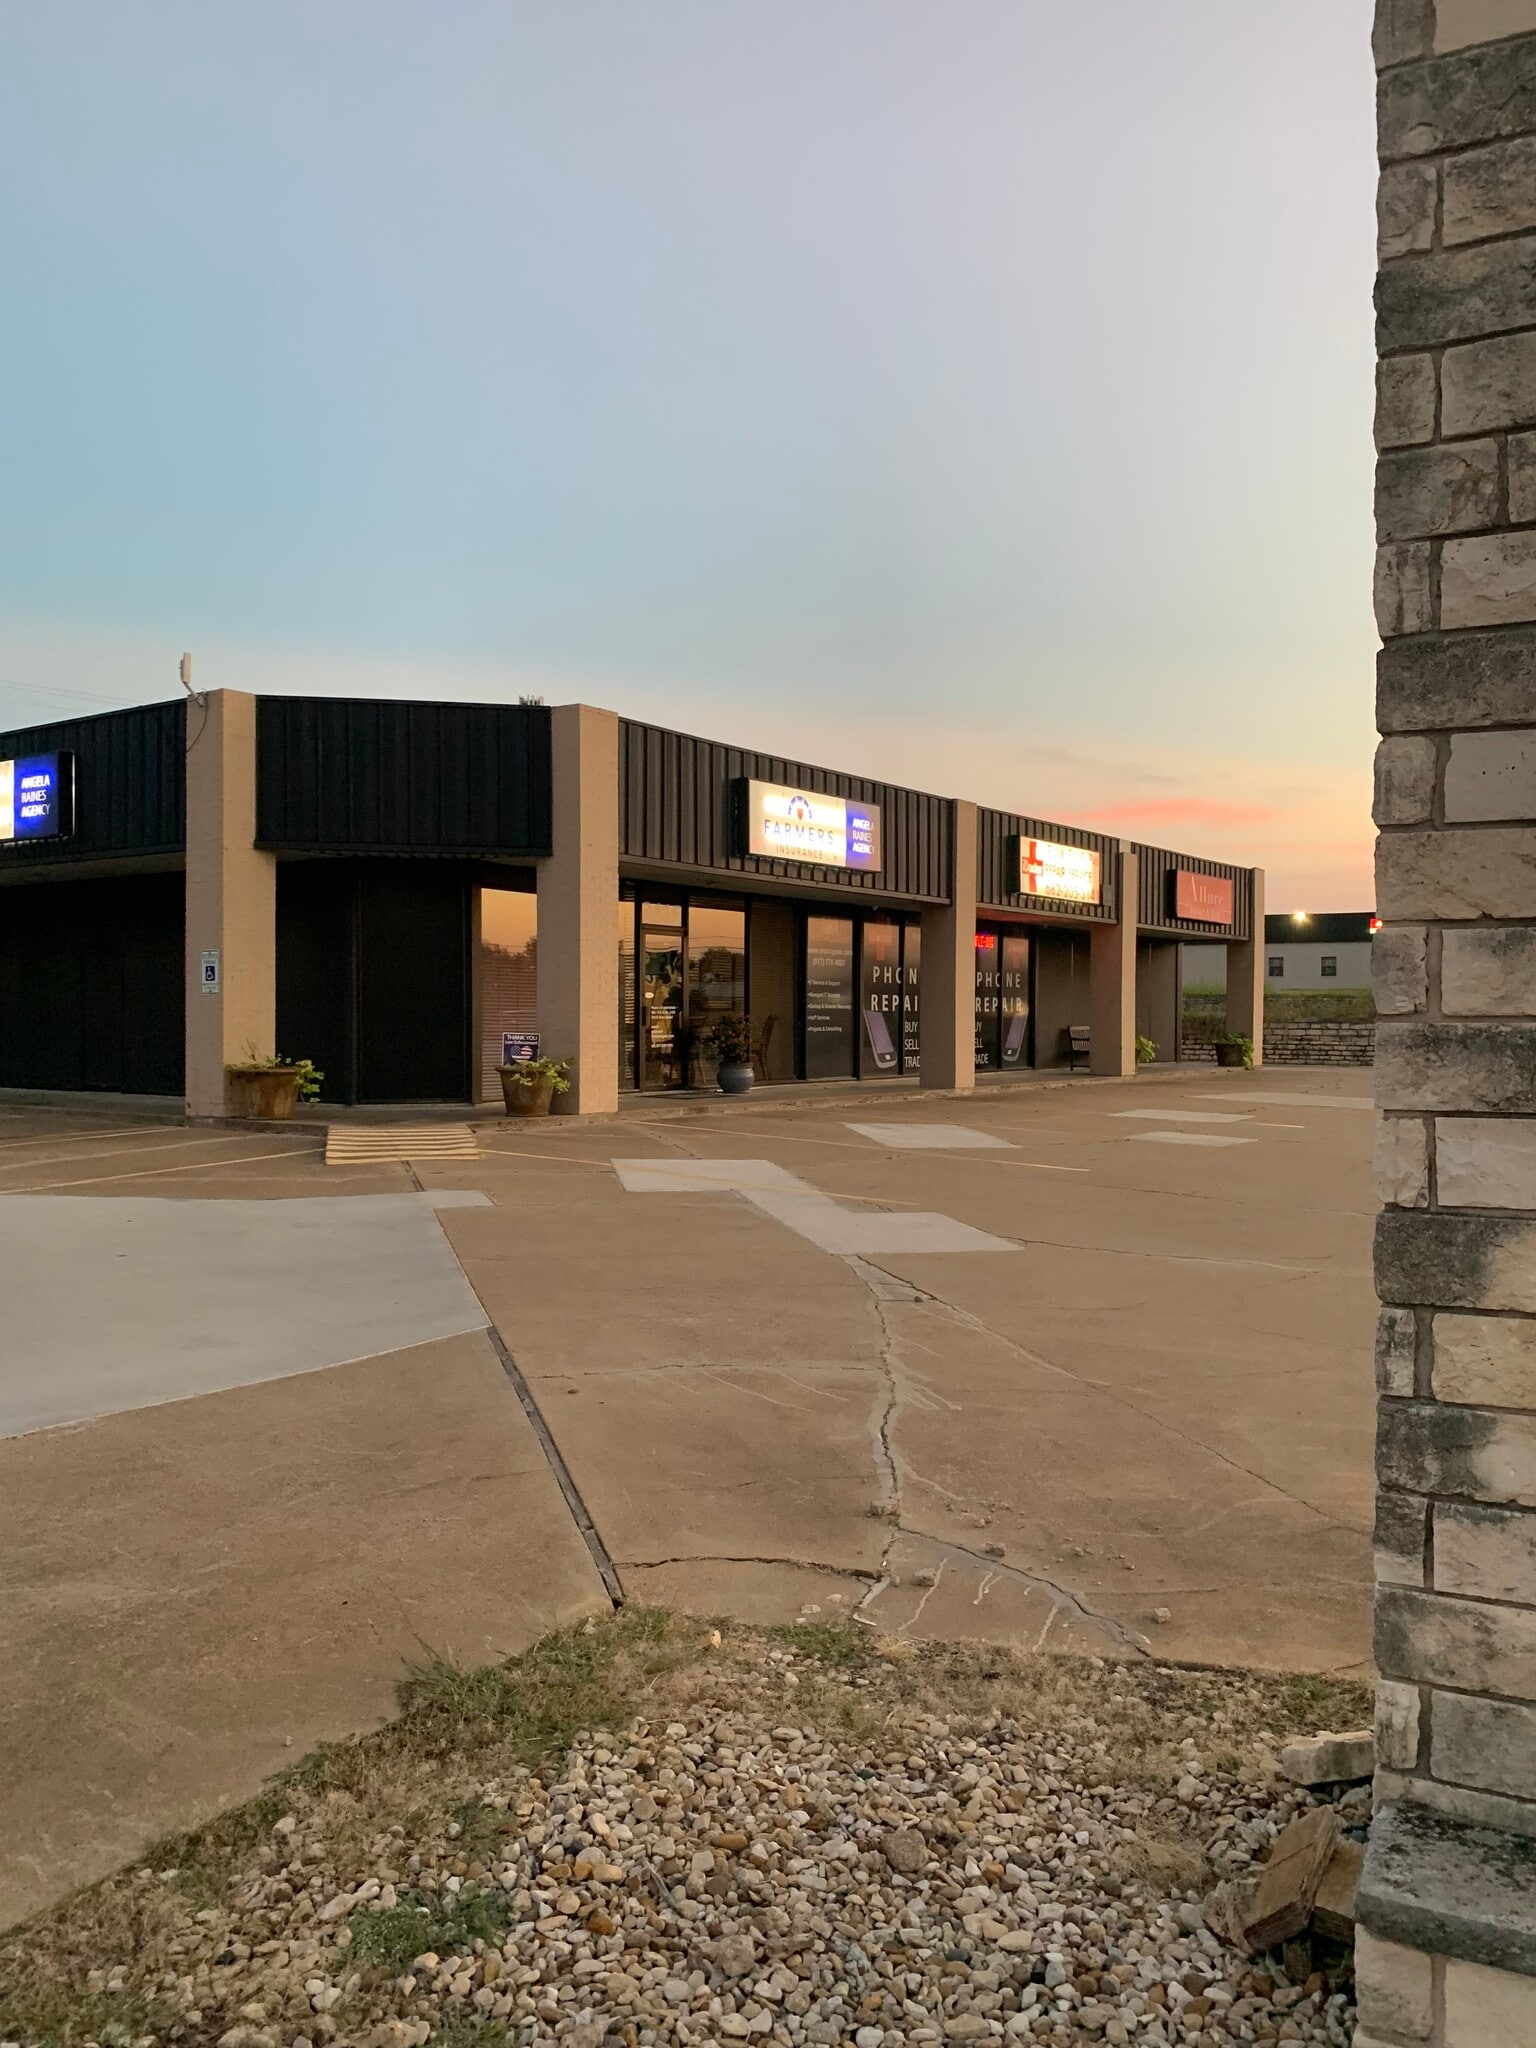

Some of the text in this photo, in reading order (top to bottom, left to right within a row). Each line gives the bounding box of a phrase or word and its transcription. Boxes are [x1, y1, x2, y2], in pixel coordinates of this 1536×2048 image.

[21, 775, 50, 789] ANGELA
[21, 790, 46, 803] RAINES
[21, 804, 50, 817] AGENCY
[852, 818, 874, 830] ANGELA
[764, 819, 834, 845] FARMERS
[852, 830, 872, 842] RAINES
[776, 845, 823, 859] INSURANCE
[872, 965, 918, 985] PHON
[976, 971, 1021, 988] PHONE
[870, 994, 919, 1012] REPAI
[975, 996, 1022, 1013] REPAIR
[904, 1021, 919, 1033] BUY
[904, 1039, 920, 1050] SELL
[904, 1056, 920, 1067] TRAD
